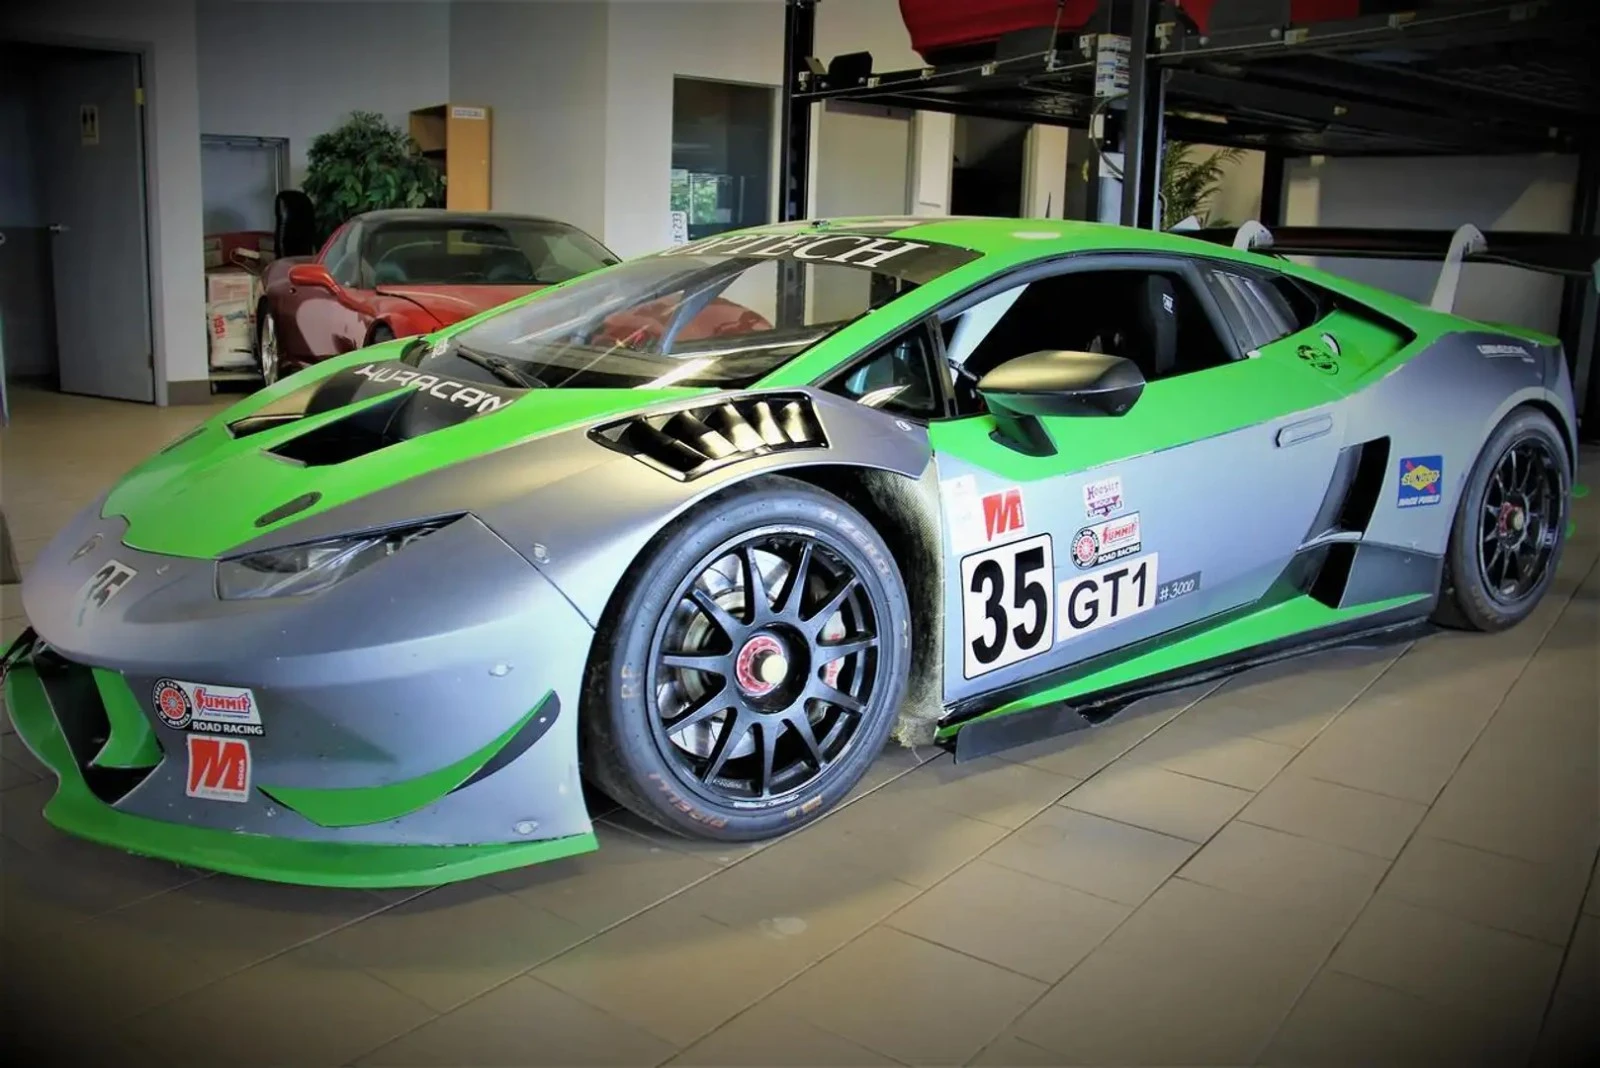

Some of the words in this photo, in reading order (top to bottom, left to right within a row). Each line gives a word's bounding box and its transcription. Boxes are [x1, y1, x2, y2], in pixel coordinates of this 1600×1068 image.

[970, 546, 1048, 665] 35
[1067, 562, 1148, 629] GT1
[194, 687, 250, 711] SUMMIT
[192, 720, 221, 733] ROAD
[223, 723, 263, 736] RACING
